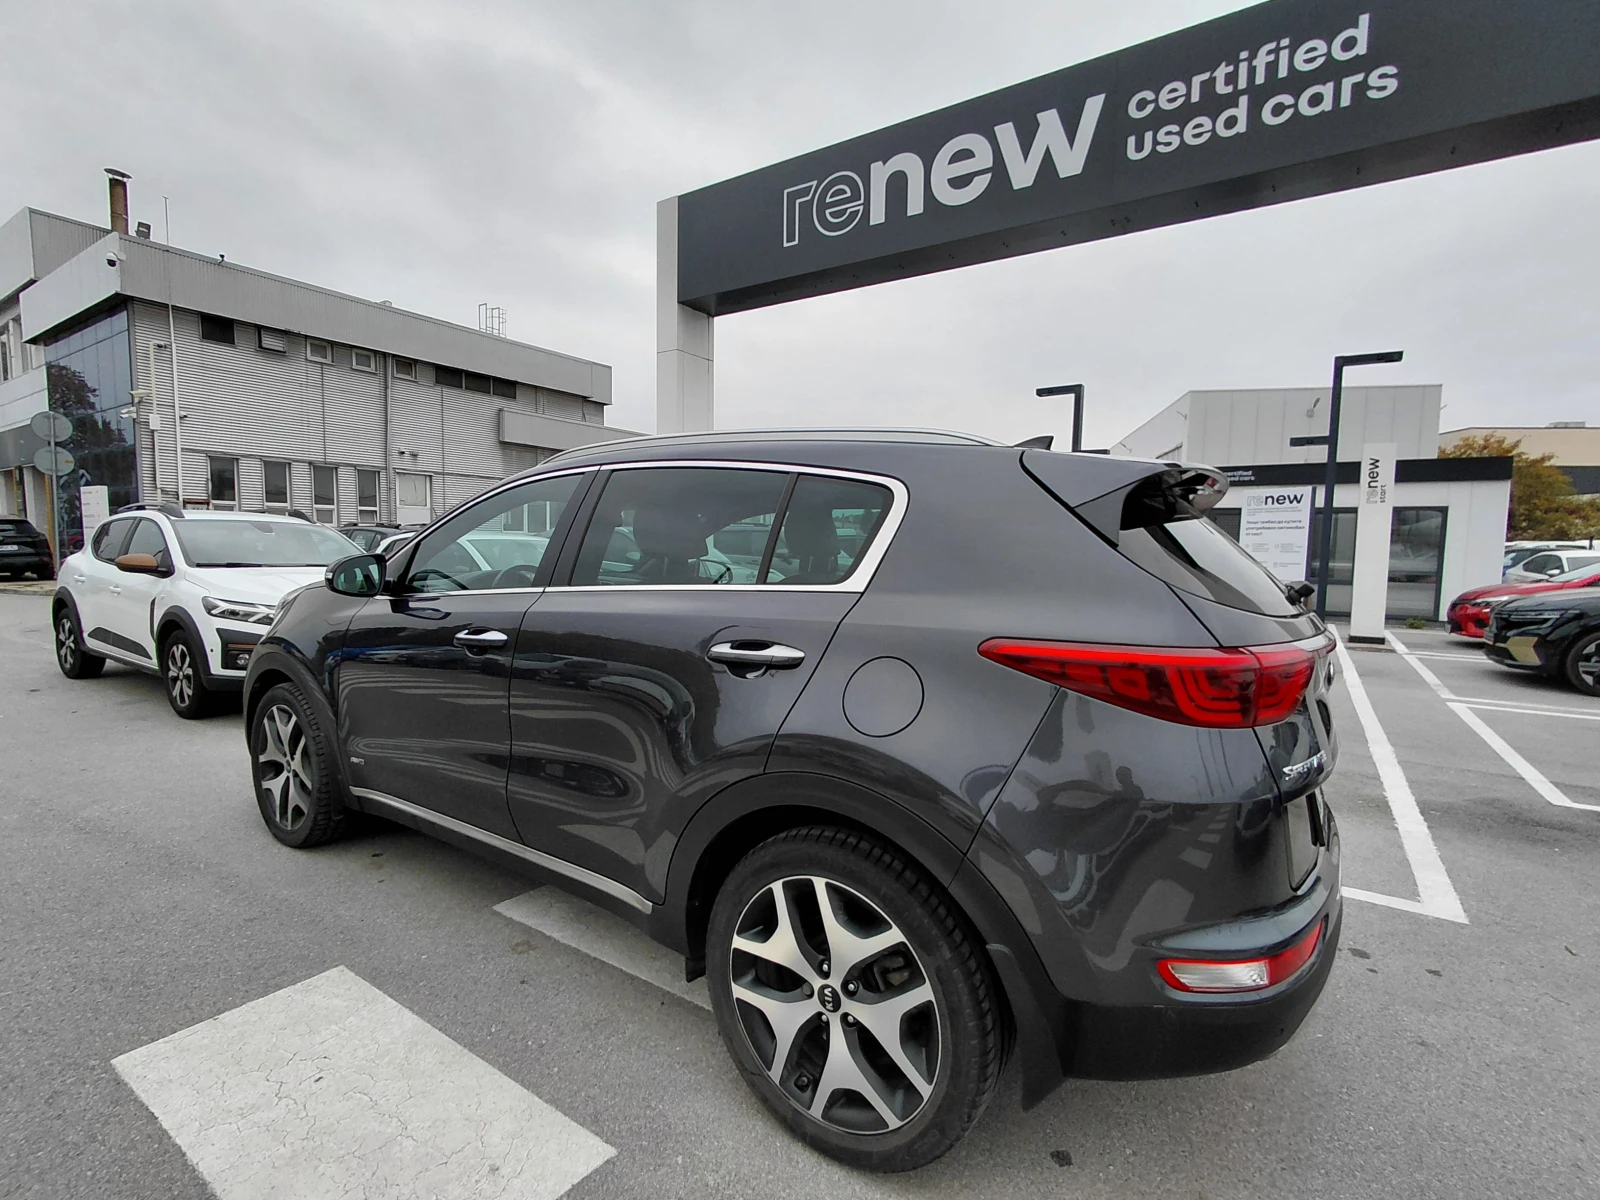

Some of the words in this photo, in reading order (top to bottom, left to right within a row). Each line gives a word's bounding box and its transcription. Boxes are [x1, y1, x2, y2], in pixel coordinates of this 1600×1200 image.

[1127, 13, 1370, 120] certified
[1126, 97, 1248, 161] used
[1261, 65, 1400, 127] cars
[782, 93, 1106, 248] renew
[1247, 493, 1304, 506] renew
[1366, 457, 1381, 504] renew
[1379, 484, 1387, 504] start
[824, 987, 833, 1010] KIA
